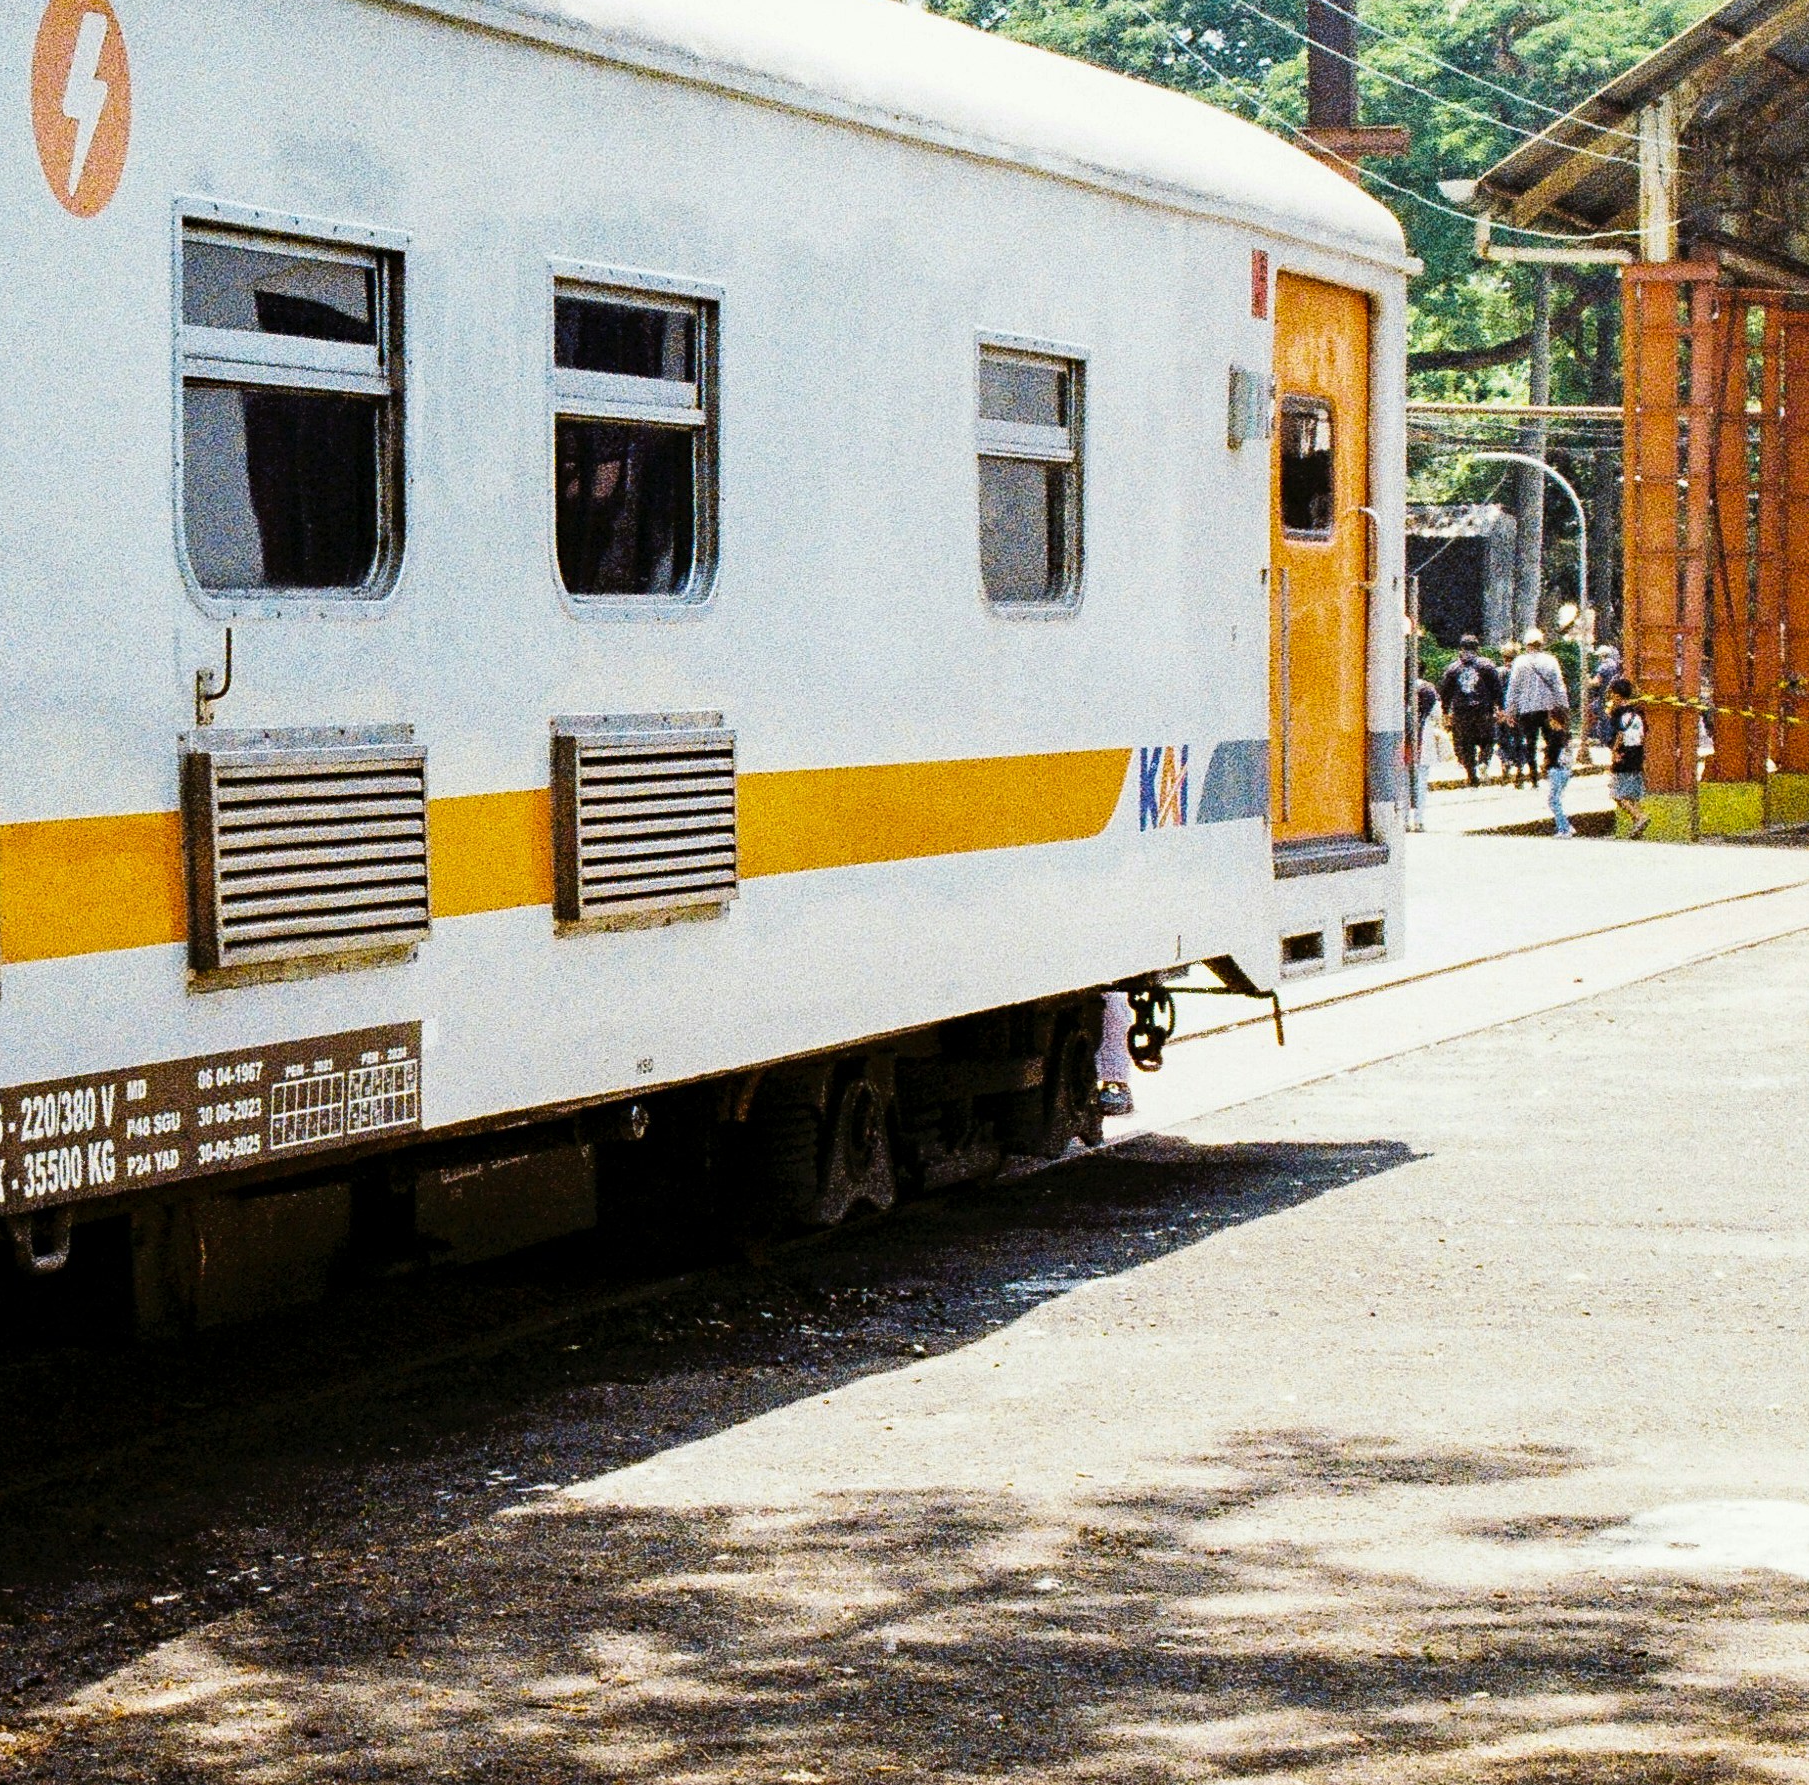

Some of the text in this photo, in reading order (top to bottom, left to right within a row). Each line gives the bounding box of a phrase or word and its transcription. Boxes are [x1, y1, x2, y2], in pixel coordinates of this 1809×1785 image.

[1139, 743, 1189, 831] KAI
[21, 1087, 96, 1142] 220/380
[101, 1084, 115, 1127] V
[24, 1145, 83, 1198] 35500
[88, 1139, 116, 1186] KG
